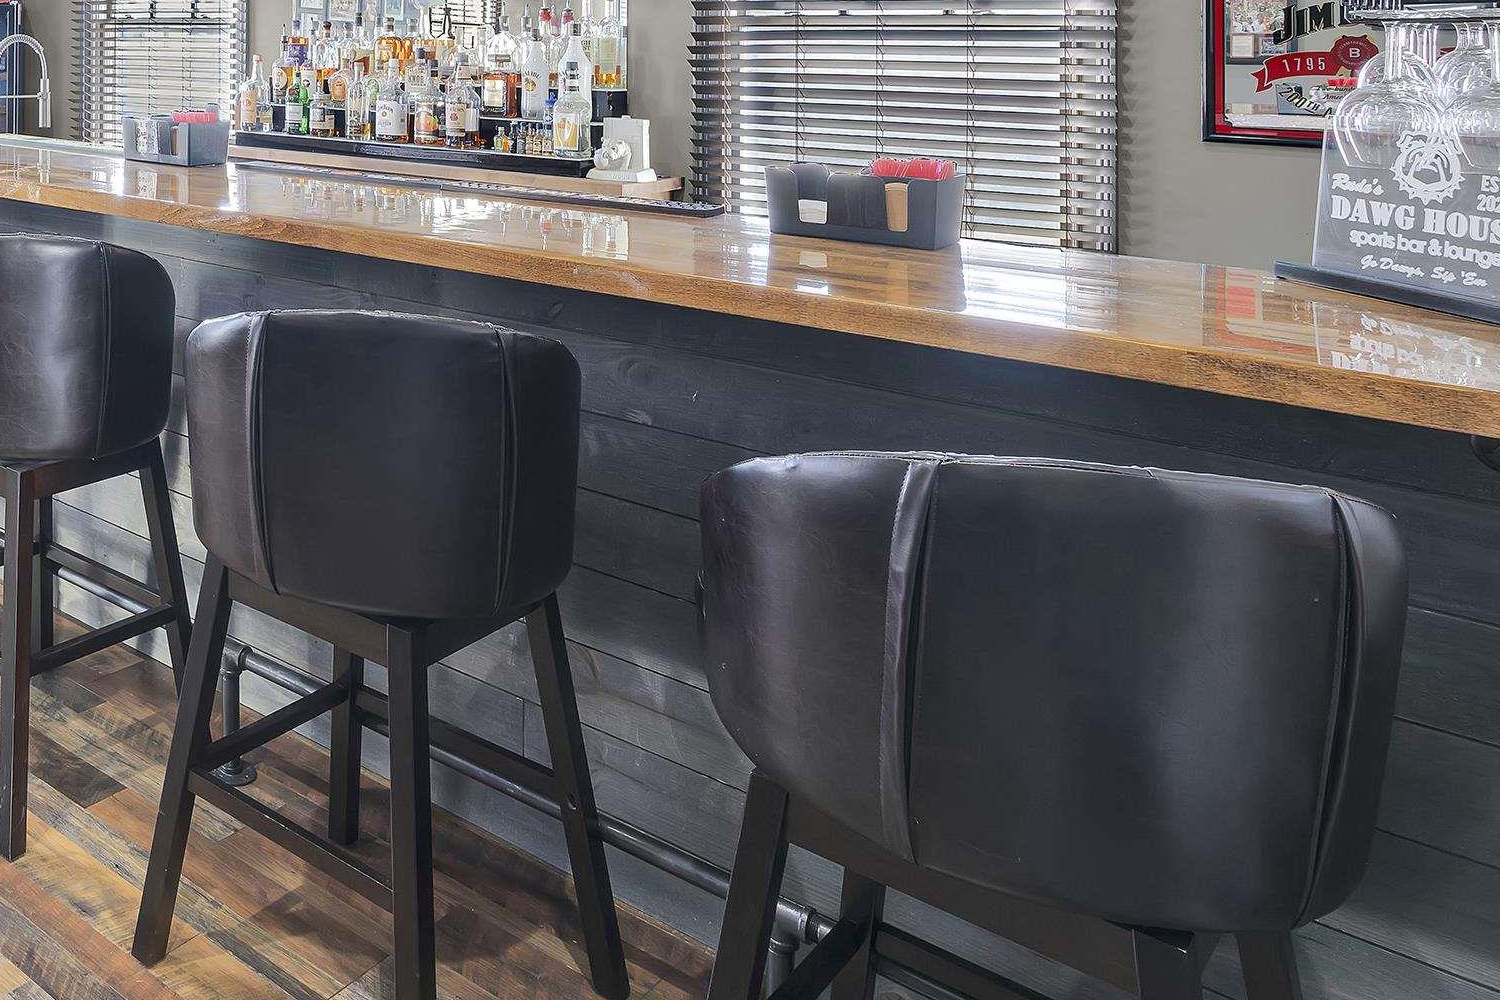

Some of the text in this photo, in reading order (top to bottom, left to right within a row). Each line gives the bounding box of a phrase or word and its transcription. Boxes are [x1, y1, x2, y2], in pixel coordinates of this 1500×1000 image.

[1272, 2, 1335, 46] JIM
[1282, 57, 1326, 72] 1795
[1349, 47, 1361, 58] B
[1279, 87, 1320, 112] 200TH
[1330, 194, 1415, 231] DAWG
[1349, 229, 1395, 249] sports
[1397, 233, 1427, 254] bar
[1428, 238, 1444, 256] &
